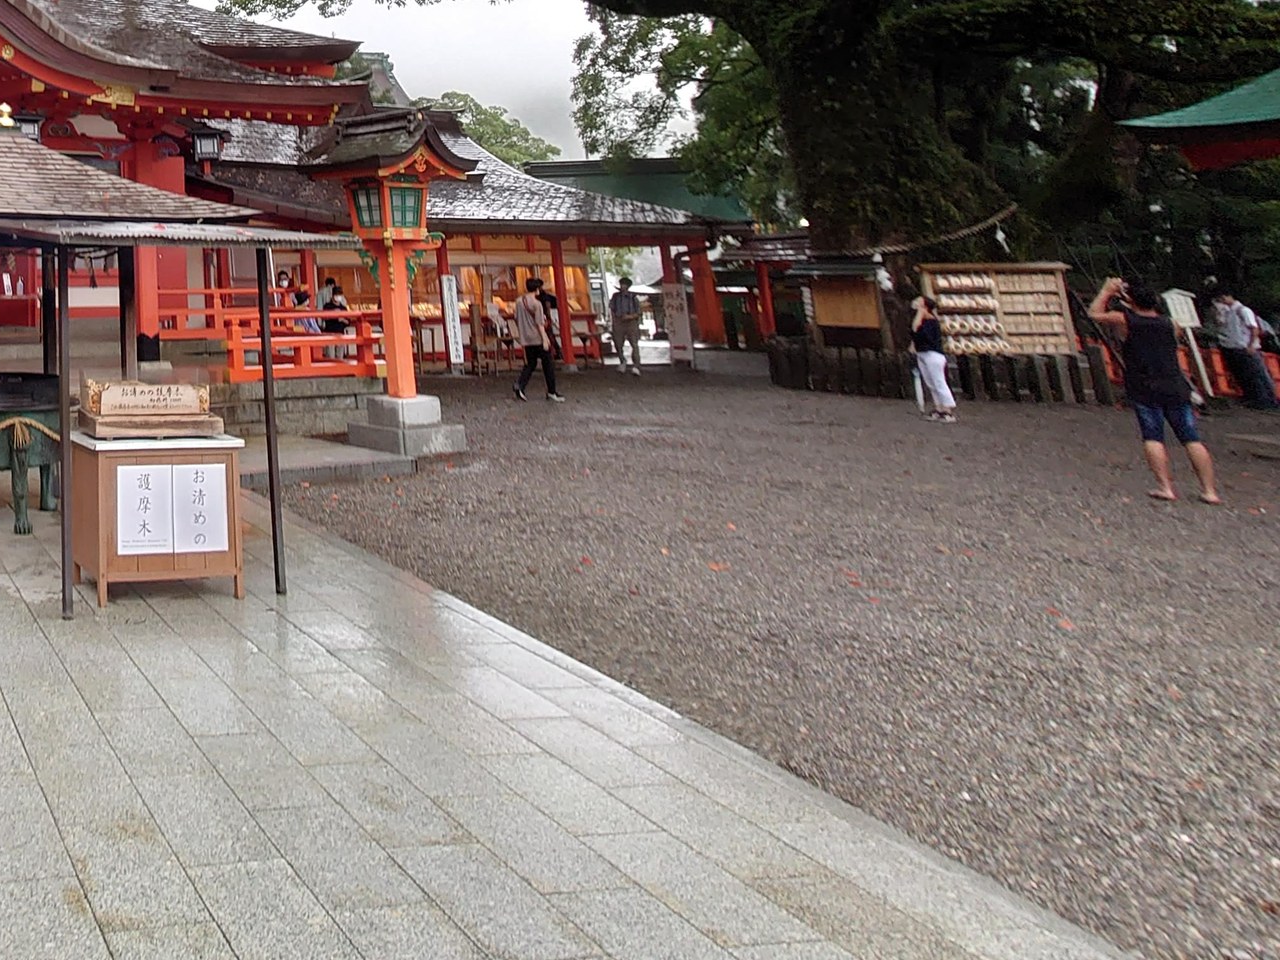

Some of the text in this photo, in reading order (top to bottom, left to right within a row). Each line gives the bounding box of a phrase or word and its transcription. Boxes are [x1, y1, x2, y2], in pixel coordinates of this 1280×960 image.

[137, 473, 152, 538] 護摩木
[192, 469, 207, 545] お清めの
